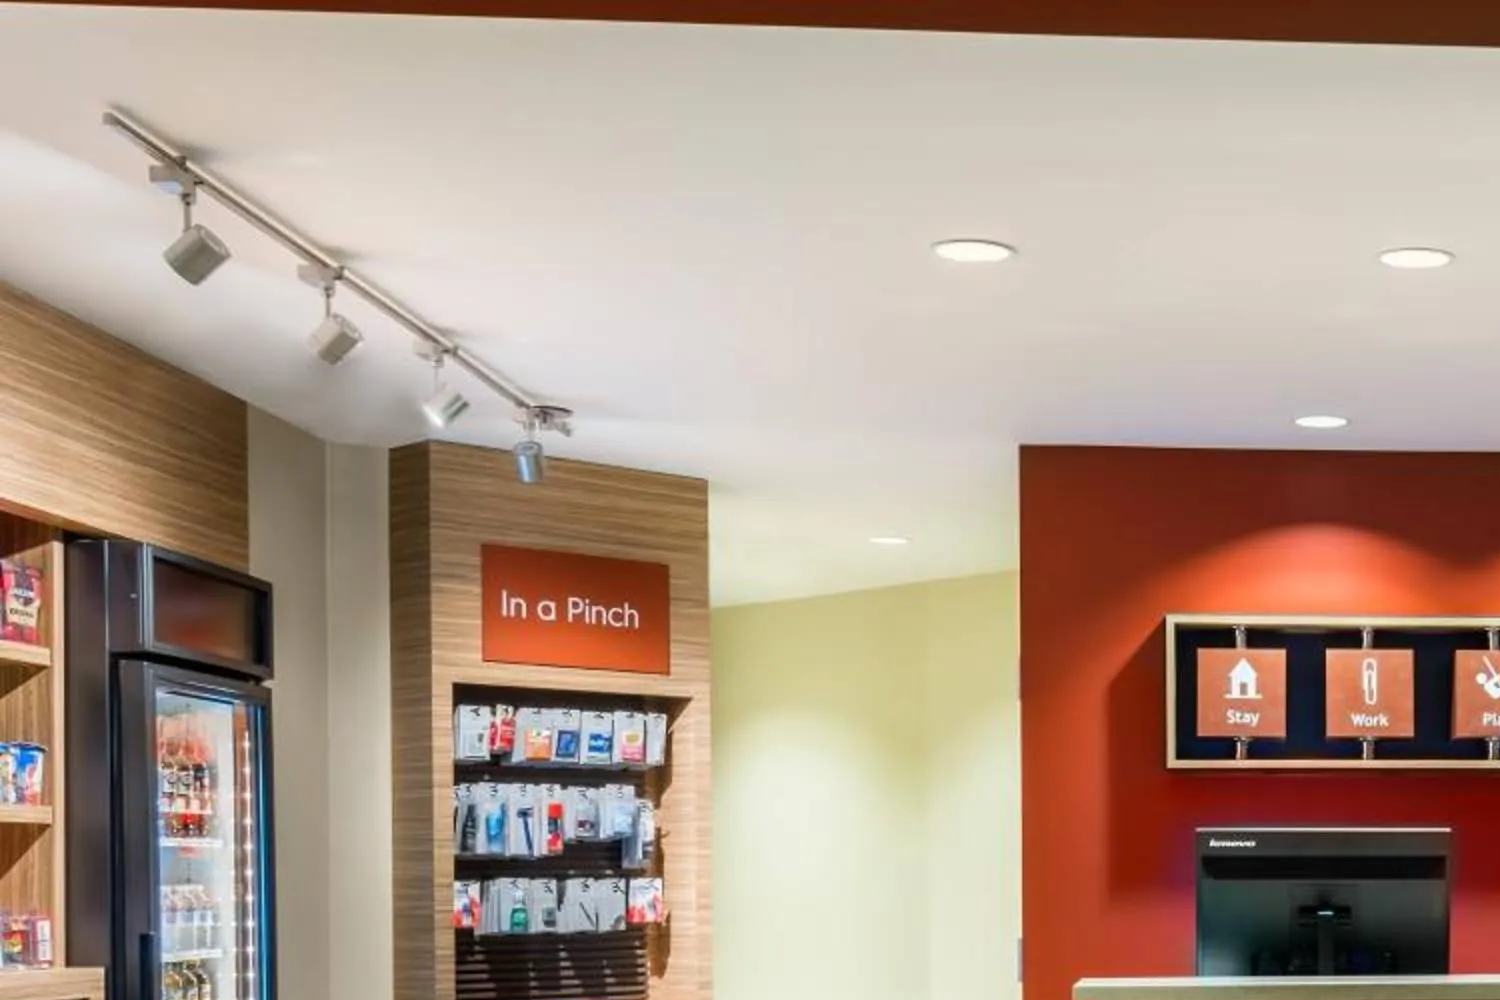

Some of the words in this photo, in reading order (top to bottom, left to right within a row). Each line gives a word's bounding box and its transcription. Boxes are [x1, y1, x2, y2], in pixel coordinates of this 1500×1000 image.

[501, 589, 527, 620] In
[537, 600, 556, 621] a
[567, 596, 639, 629] Pinch
[1226, 709, 1259, 727] Stay
[1350, 713, 1389, 728] Work
